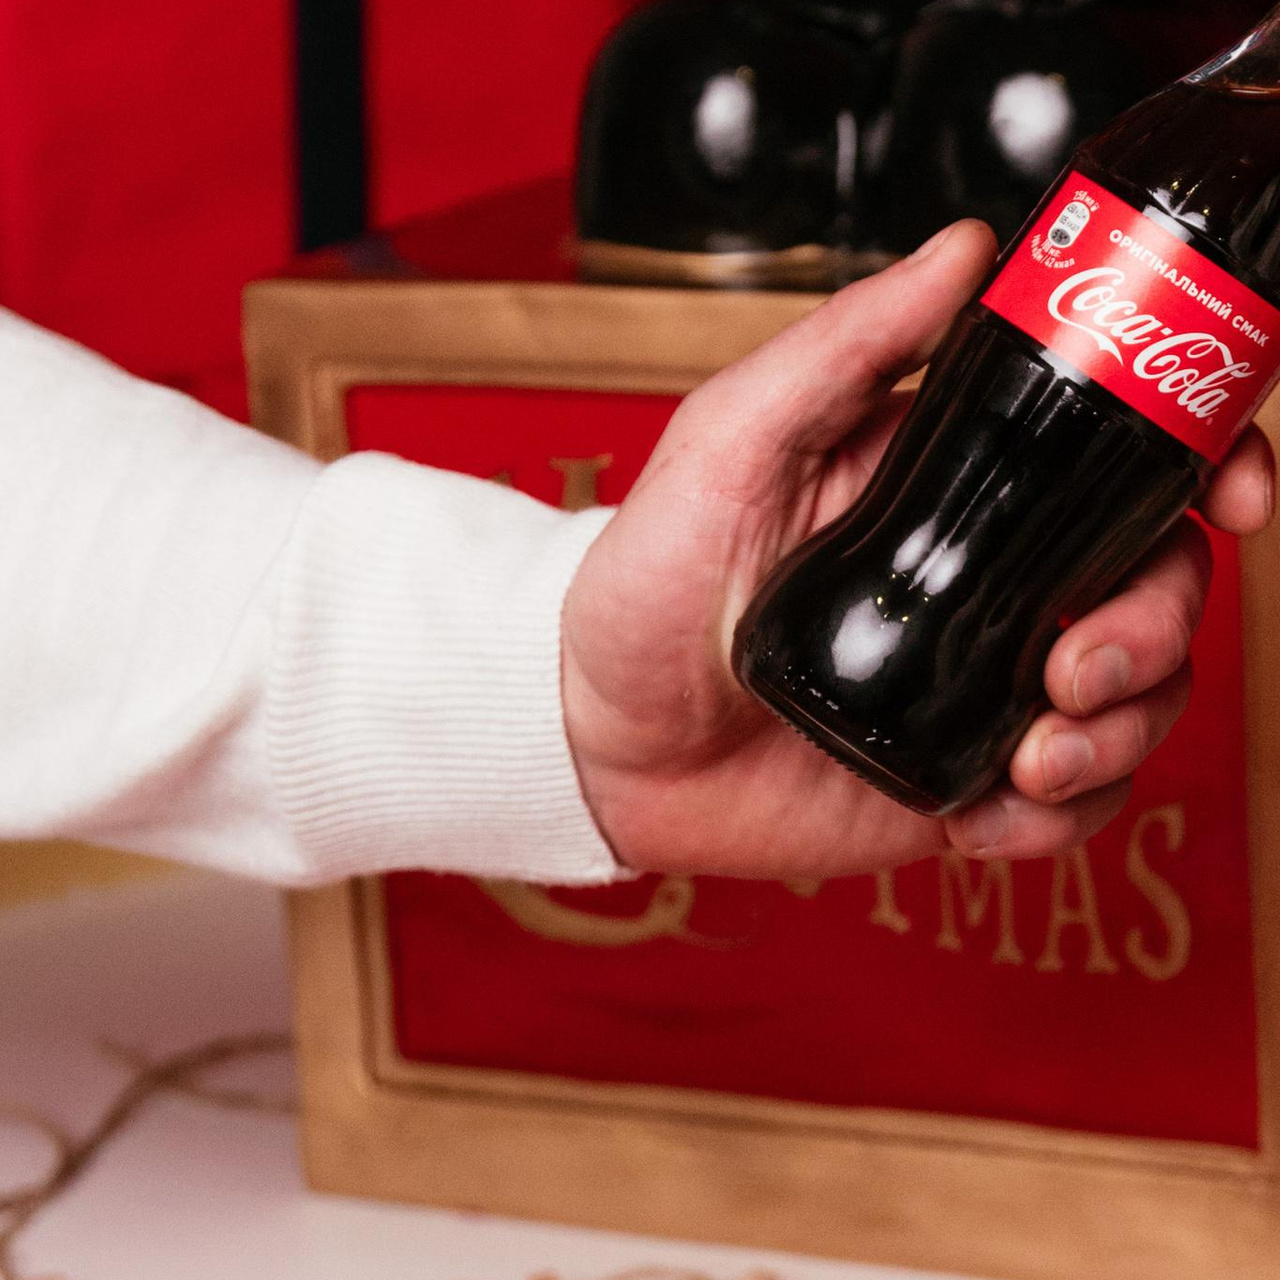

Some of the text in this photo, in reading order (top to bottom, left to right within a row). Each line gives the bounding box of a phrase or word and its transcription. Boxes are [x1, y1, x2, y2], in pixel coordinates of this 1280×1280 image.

[1048, 267, 1256, 419] Coca-Cola
[1109, 228, 1270, 347] ОРИГІНАЛЬНИЙ СМАК
